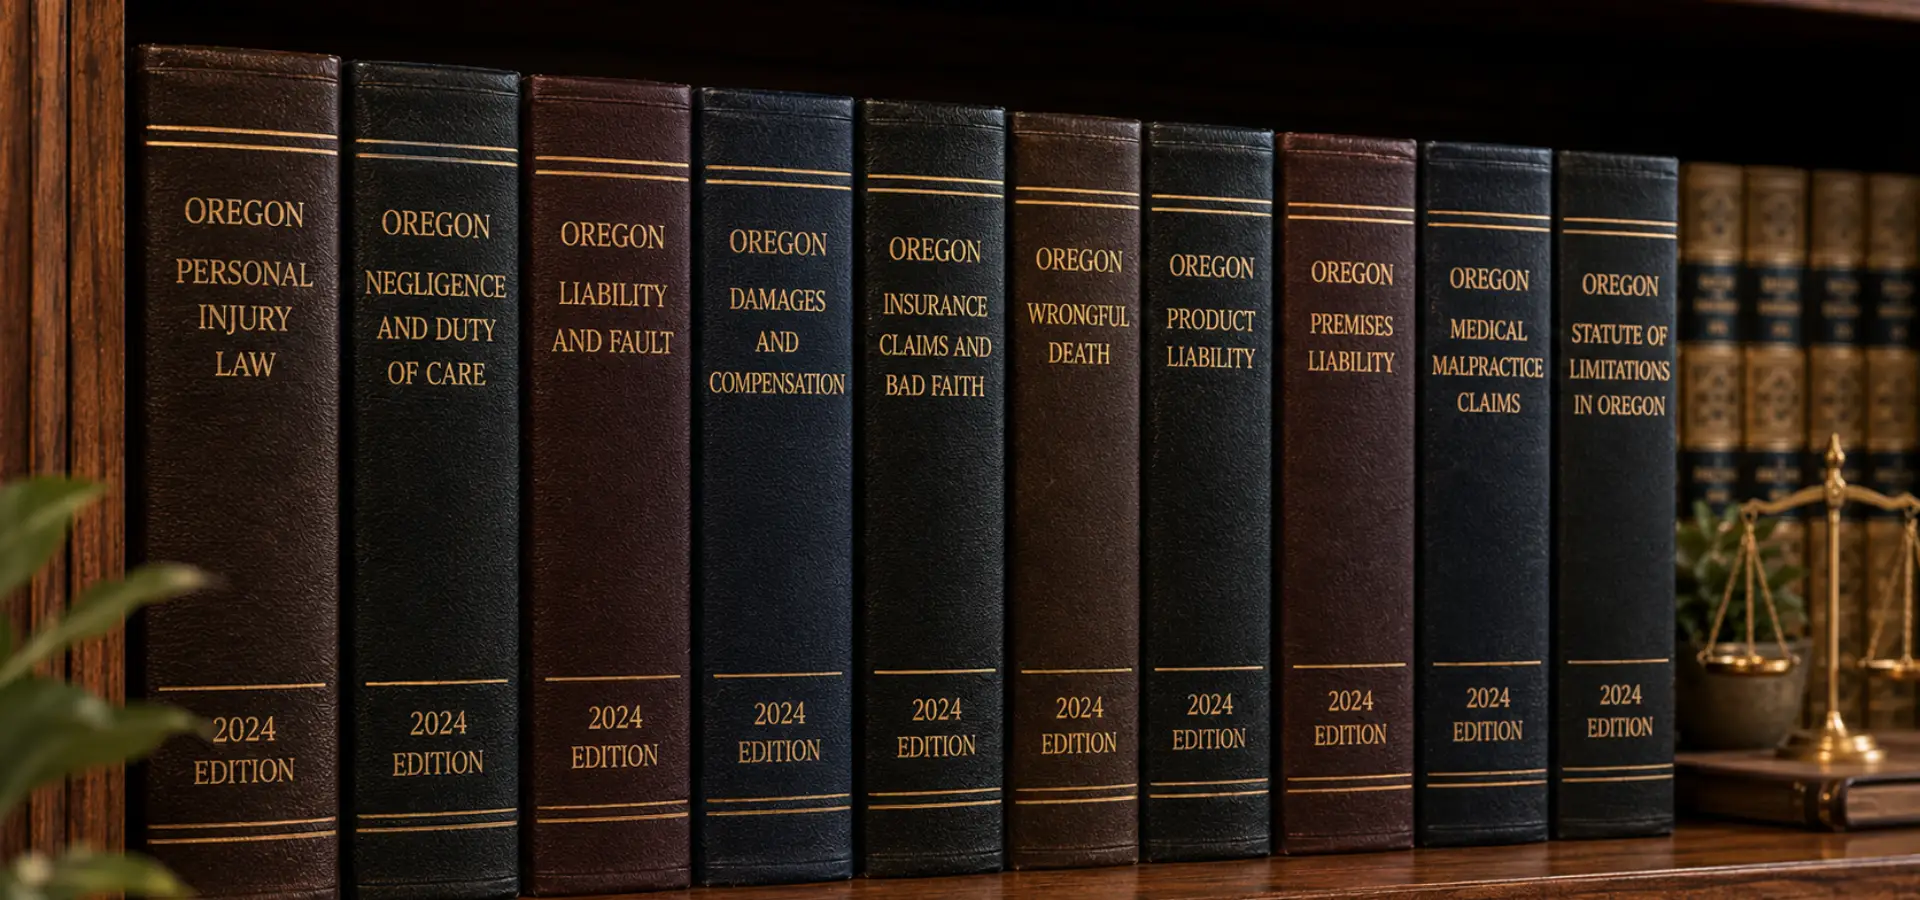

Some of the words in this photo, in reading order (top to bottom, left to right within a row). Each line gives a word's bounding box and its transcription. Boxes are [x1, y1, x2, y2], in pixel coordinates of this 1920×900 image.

[185, 197, 304, 227] OREGON
[382, 210, 489, 238] OREGON
[561, 221, 664, 249] OREGON
[730, 230, 826, 255] OREGON
[890, 237, 980, 262] OREGON
[1036, 247, 1122, 273] OREGON
[1170, 254, 1253, 279] OREGON
[176, 259, 313, 287] PERSONAL
[366, 271, 504, 298] NEGLIGENCE
[1312, 261, 1393, 286] OREGON
[1450, 268, 1528, 291] OREGON
[1583, 273, 1658, 296] OREGON
[559, 281, 668, 307] LIABILITY
[730, 288, 825, 312] DAMAGES
[884, 293, 987, 317] INSURANCE
[199, 304, 292, 335] INJURY
[1027, 303, 1129, 327] WRONGFUL
[1168, 308, 1256, 332] PRODUCT
[1310, 313, 1393, 336] PREMISES
[377, 316, 427, 339] AND
[436, 318, 495, 341] DUTY
[1451, 319, 1527, 341] MEDICAL
[1572, 324, 1642, 344] STATUTE
[1647, 326, 1667, 345] OF
[552, 329, 602, 352] AND
[609, 330, 674, 354] FAULT
[757, 331, 798, 352] AND
[880, 334, 948, 356] CLAIMS
[954, 336, 991, 357] AND
[1049, 342, 1110, 364] DEATH
[216, 352, 275, 376] LAW
[1168, 346, 1254, 368] LIABILITY
[1308, 351, 1395, 373] LIABILITY
[1432, 355, 1543, 378] MALPRACTICE
[388, 362, 418, 384] OF
[427, 362, 486, 385] CARE
[1570, 359, 1670, 381] LIMITATIONS
[710, 372, 844, 394] COMPENSATION
[887, 375, 925, 395] BAD
[932, 376, 984, 396] FAITH
[1458, 392, 1520, 413] CLAIMS
[1575, 395, 1592, 414] IN
[1598, 395, 1665, 416] OREGON
[1188, 694, 1232, 715] 2024
[1329, 690, 1373, 711] 2024
[1467, 688, 1510, 708] 2024
[1601, 685, 1641, 704] 2024
[589, 705, 643, 729] 2024
[755, 702, 805, 725] 2024
[913, 698, 961, 720] 2024
[1056, 696, 1104, 718] 2024
[212, 716, 276, 742] 2024
[411, 711, 466, 735] 2024
[1315, 723, 1386, 745] EDITION
[1454, 720, 1522, 741] EDITION
[1588, 717, 1653, 737] EDITION
[898, 735, 975, 757] EDITION
[1042, 732, 1116, 754] EDITION
[1173, 729, 1245, 749] EDITION
[572, 744, 658, 768] EDITION
[739, 740, 819, 763] EDITION
[195, 758, 294, 784] EDITION
[393, 751, 482, 776] EDITION
